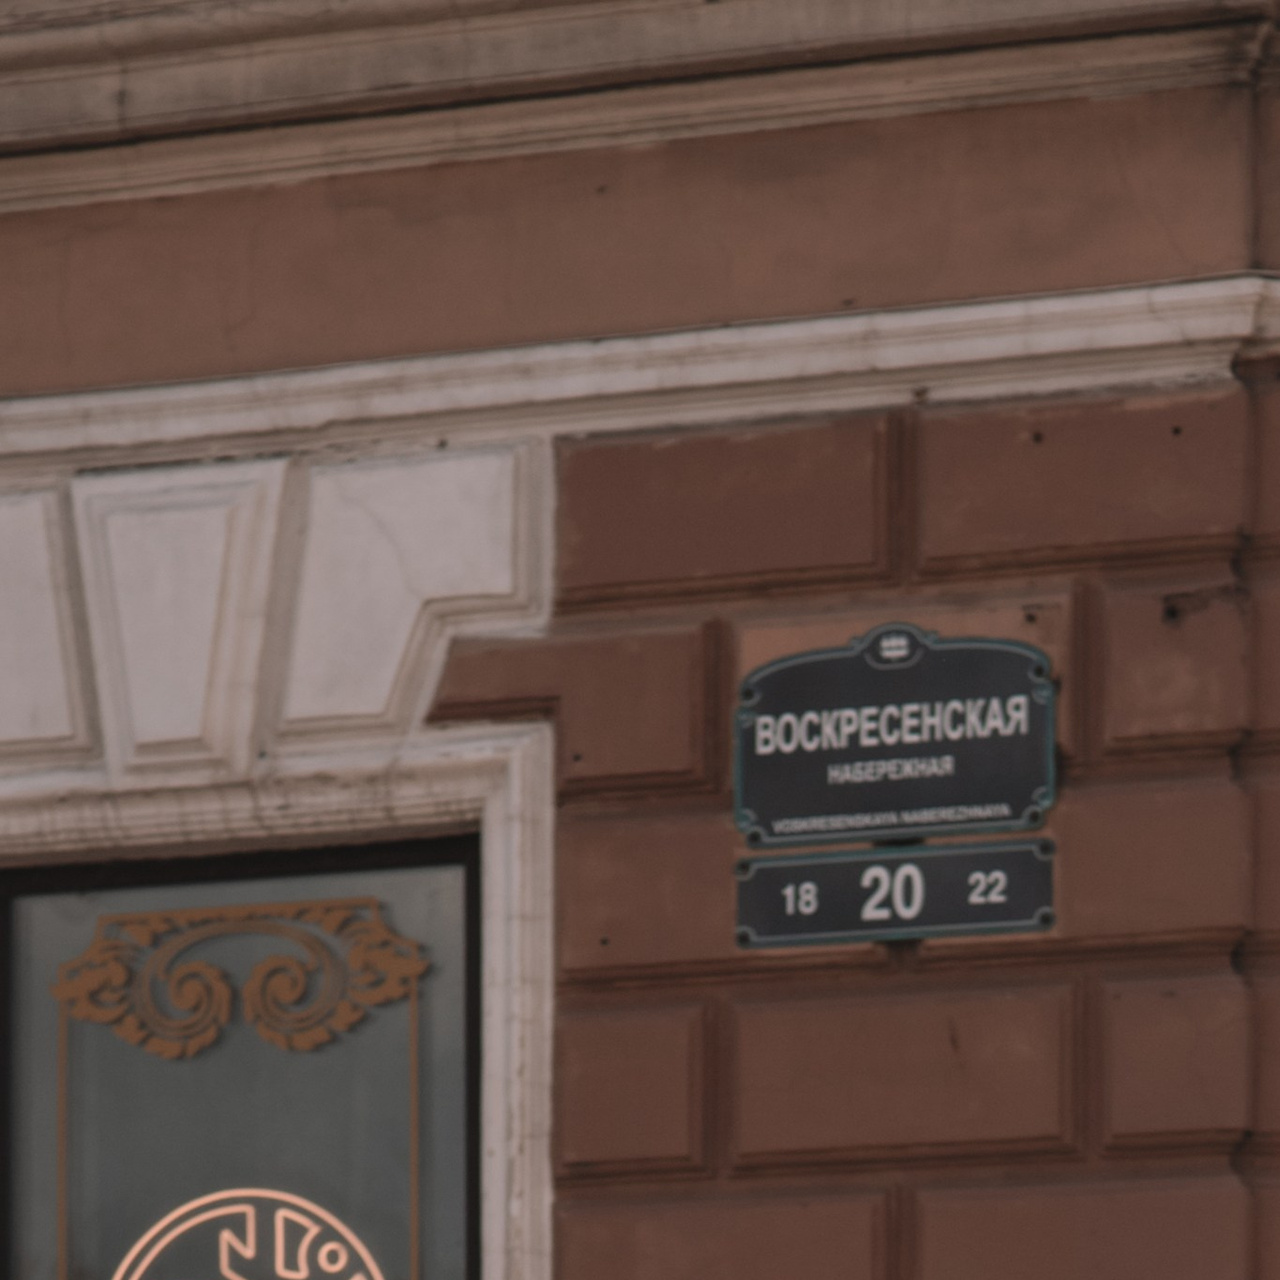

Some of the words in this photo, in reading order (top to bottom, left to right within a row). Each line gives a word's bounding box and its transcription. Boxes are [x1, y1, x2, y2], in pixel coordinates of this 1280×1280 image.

[755, 695, 1030, 756] ВОСКРЕСЕНСКАЯ
[826, 755, 956, 785] НАБЕРЕЖНАЯ
[781, 880, 819, 915] 18
[859, 863, 926, 922] 20
[967, 870, 1009, 905] 22
